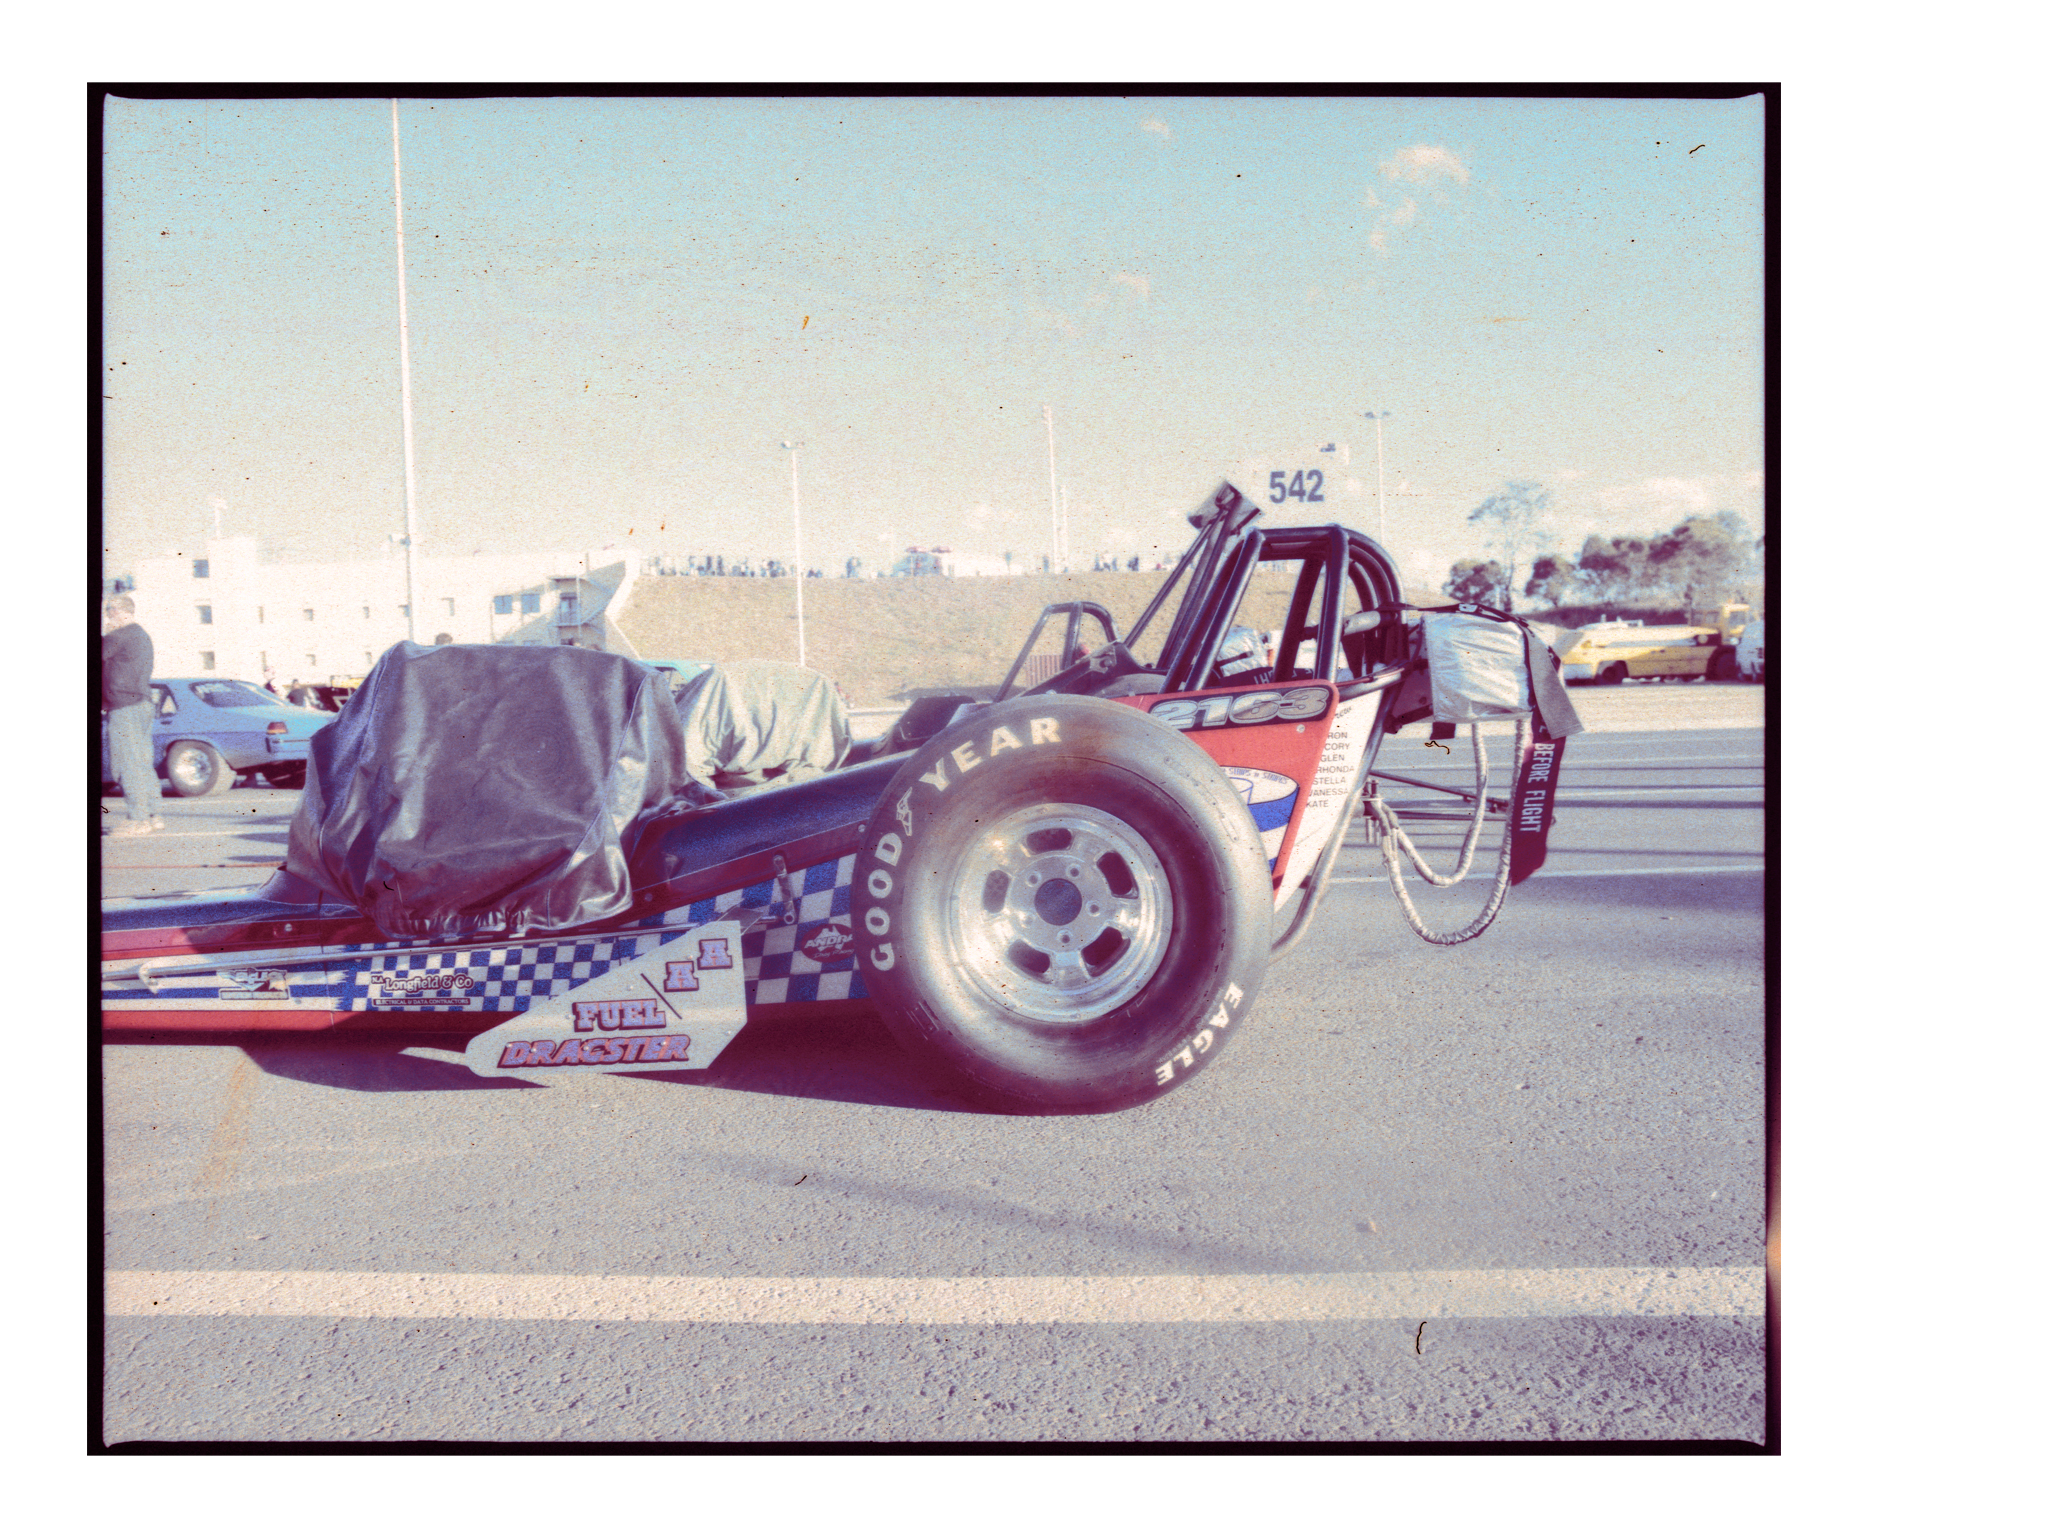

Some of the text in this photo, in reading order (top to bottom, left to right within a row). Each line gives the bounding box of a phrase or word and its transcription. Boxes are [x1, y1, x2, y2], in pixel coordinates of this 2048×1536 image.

[1269, 469, 1324, 504] 542
[1149, 687, 1330, 728] 2163
[1324, 742, 1350, 751] CORY
[1327, 731, 1348, 740] RON
[1317, 765, 1355, 774] RHONDA
[1320, 754, 1345, 762] GLEN
[1312, 776, 1346, 785] STELLA
[1520, 743, 1555, 832] BEFORE FLIGHT
[384, 976, 440, 993] Longfield
[455, 975, 473, 988] Co
[572, 999, 666, 1033] FUEL
[1155, 981, 1244, 1086] EAGLE
[497, 1034, 691, 1069] DRAGSTER
